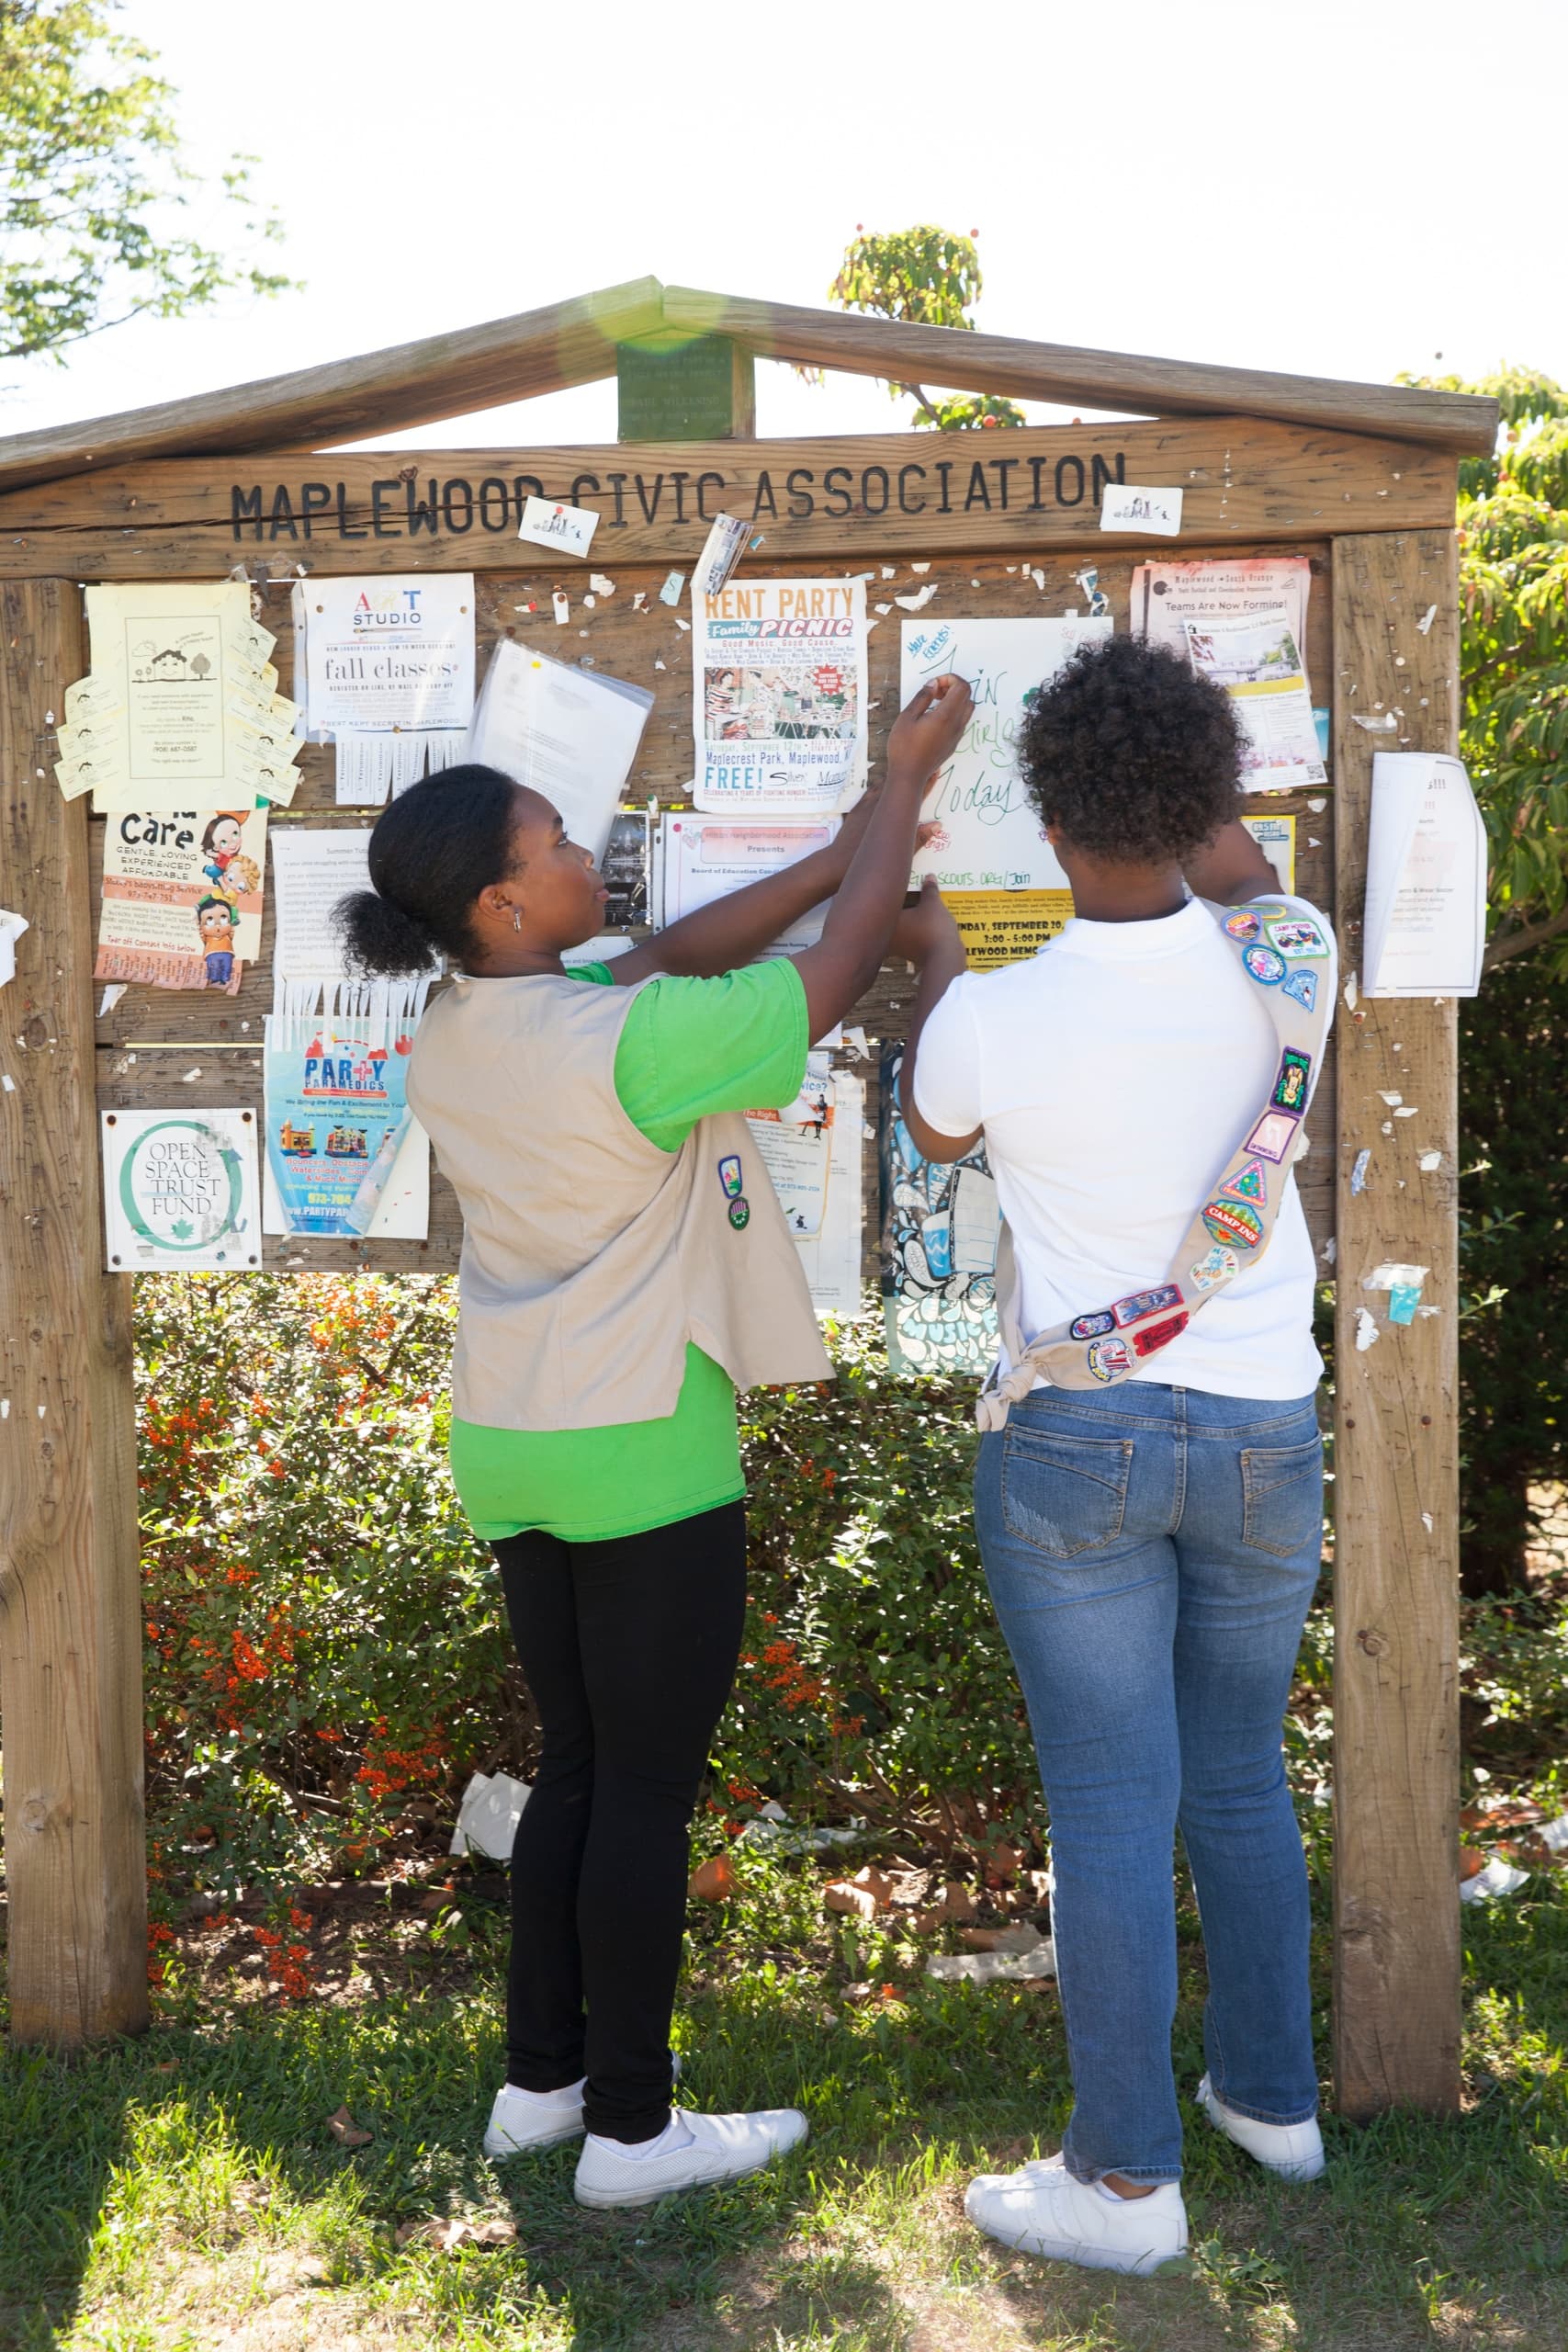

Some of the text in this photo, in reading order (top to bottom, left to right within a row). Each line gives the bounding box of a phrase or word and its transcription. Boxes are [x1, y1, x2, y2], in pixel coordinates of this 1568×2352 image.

[571, 470, 726, 529] CIVIC
[751, 451, 1127, 522] ASSOCIATION
[705, 587, 853, 619] RENT PARTY
[1165, 602, 1196, 611] Teams
[1198, 602, 1216, 610] Are
[1219, 601, 1240, 610] Now
[353, 613, 422, 626] STUDIO
[711, 618, 853, 638] Family PICNIC
[325, 656, 452, 680] fall classes
[705, 752, 755, 766] Maplecrest
[761, 752, 784, 764] Park,
[789, 751, 842, 766] Maplewood,
[705, 766, 762, 790] FREE!
[120, 812, 194, 851] Care
[120, 856, 192, 871] EXPERIENCED
[161, 851, 198, 862] LOVING
[122, 866, 189, 881] AFFORDABLE
[957, 922, 990, 932] NDAY,
[992, 921, 1049, 931] SEPTEMBER
[1013, 933, 1033, 943] 5:00
[1036, 933, 1051, 942] PM
[965, 947, 1009, 956] LEWOOD
[304, 1078, 384, 1091] PARAMEDICS
[757, 1111, 778, 1121] Right
[150, 1142, 207, 1160] OPEN
[145, 1160, 210, 1179] SPACE
[150, 1178, 221, 1196] TRUST
[152, 1197, 212, 1216] FUND
[1208, 1207, 1258, 1242] CAMP INS
[903, 1317, 982, 1344] MUSIC
